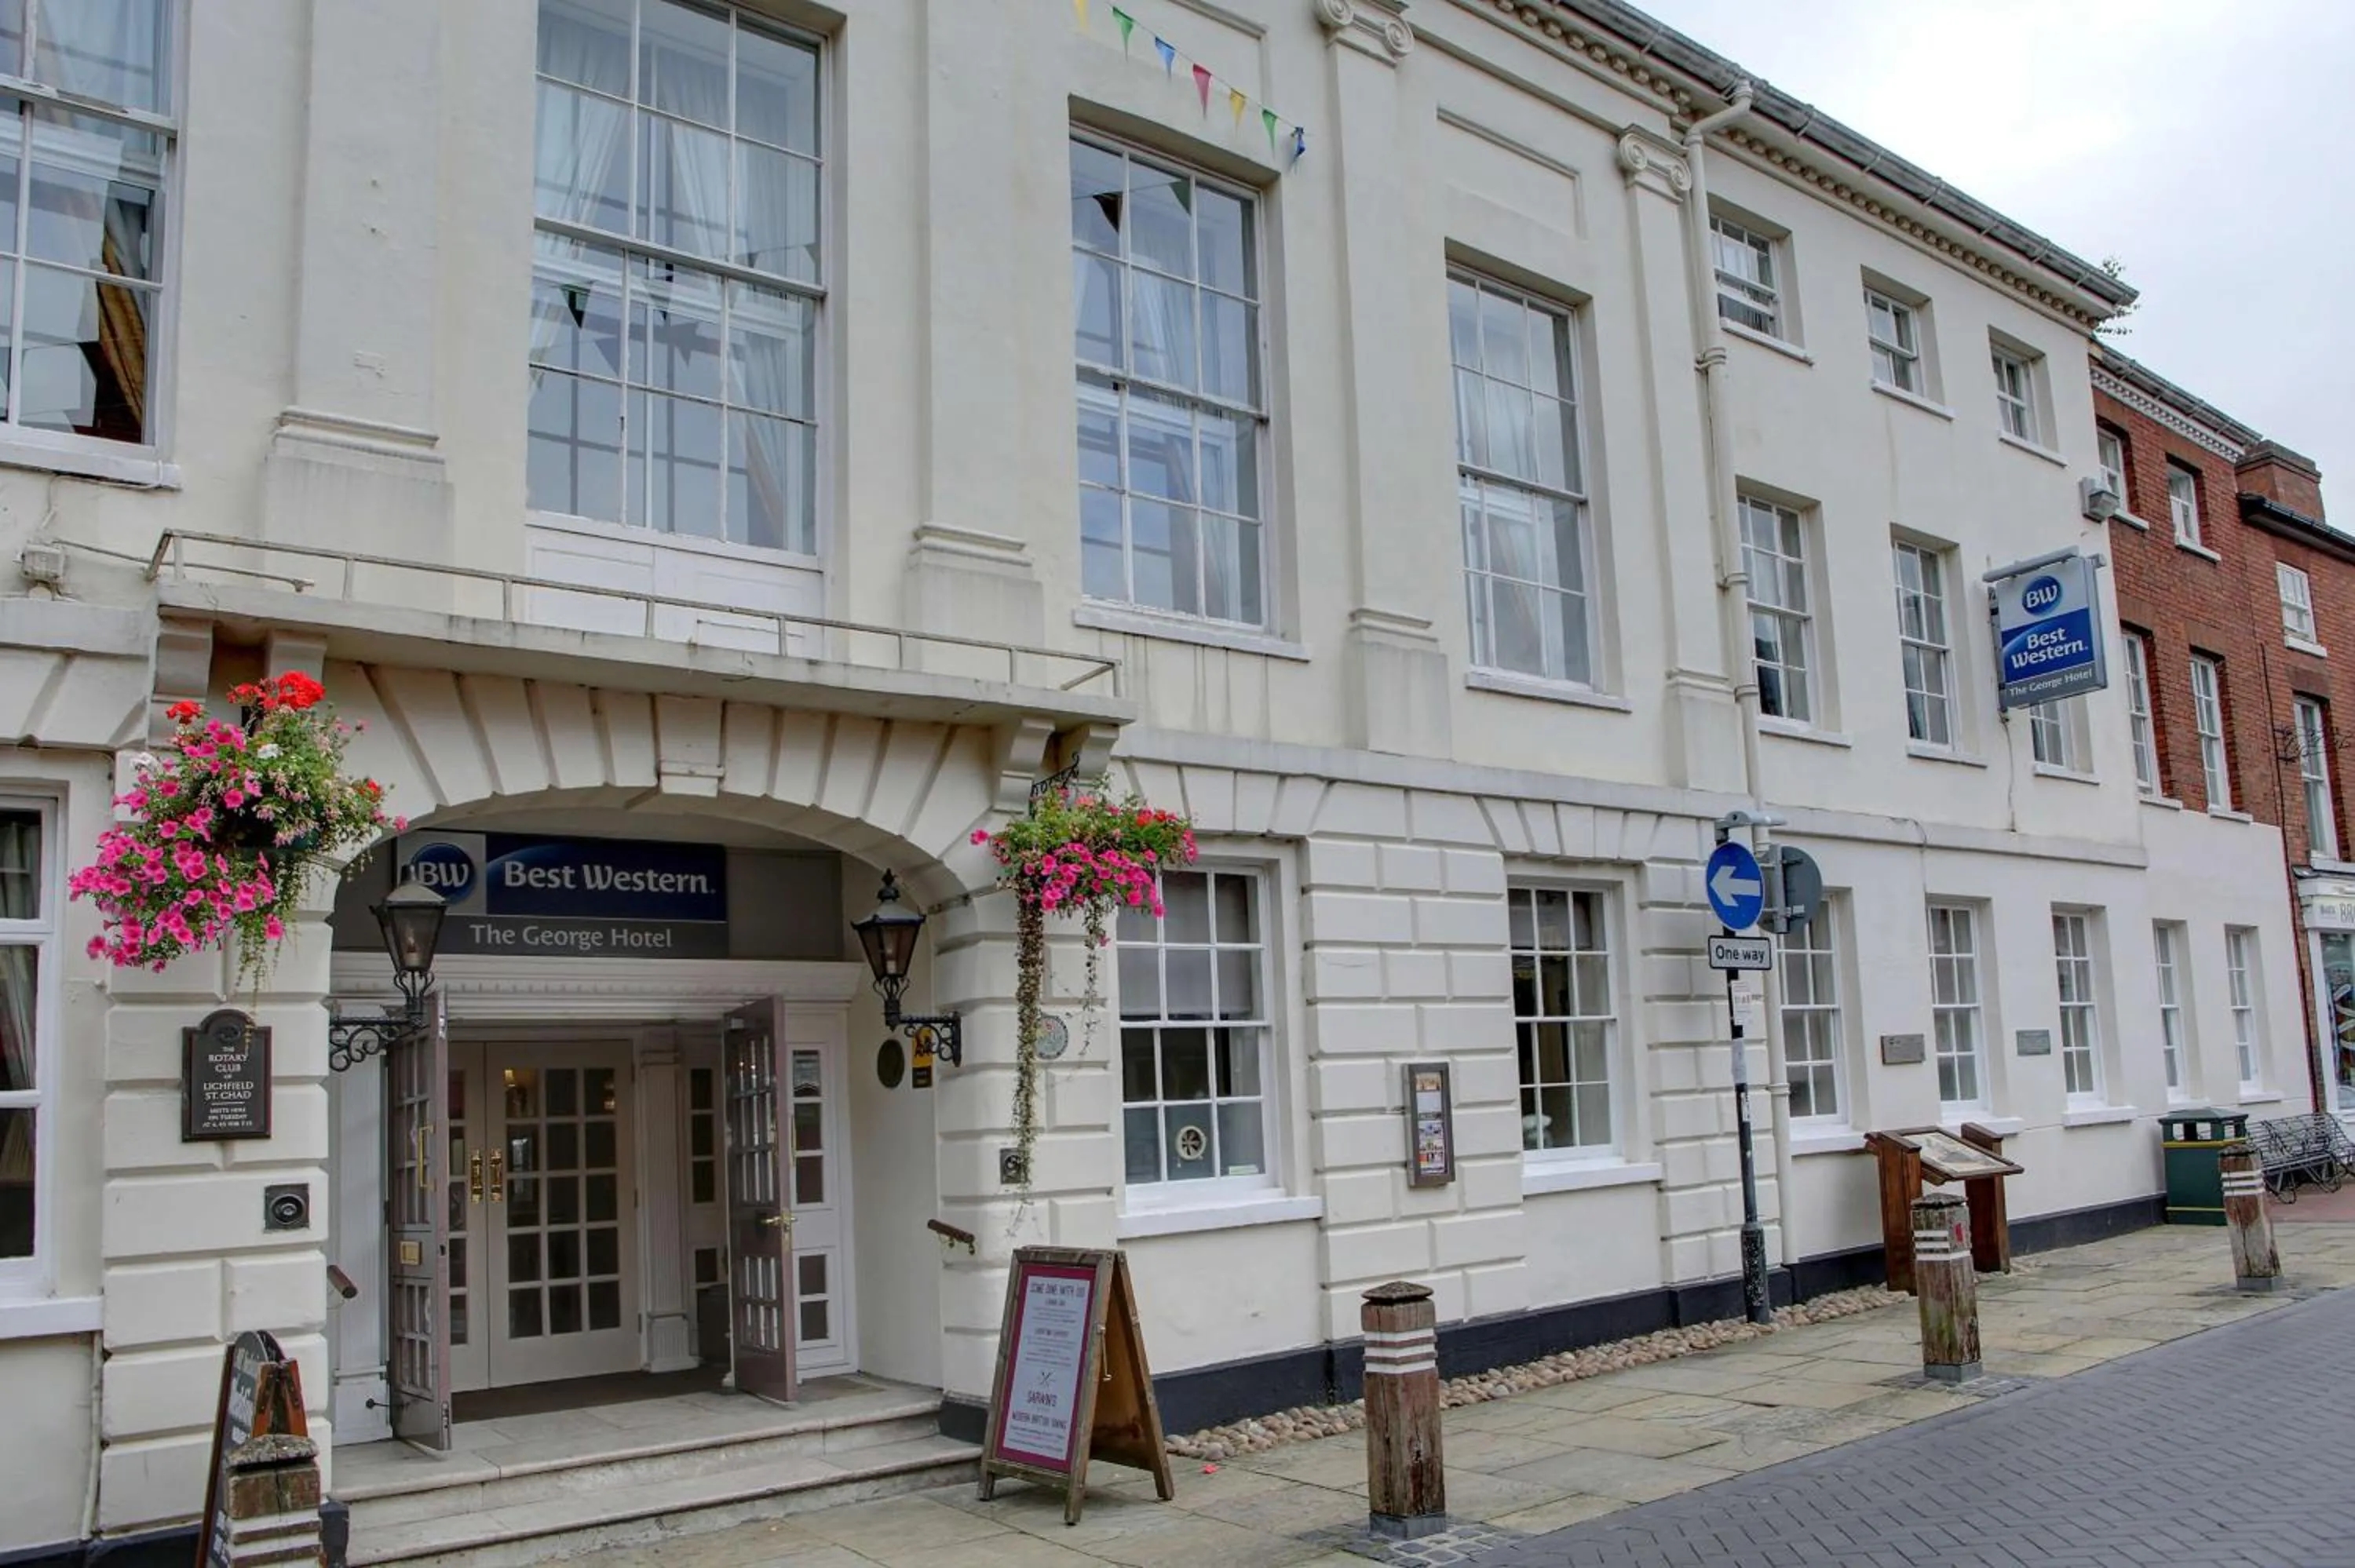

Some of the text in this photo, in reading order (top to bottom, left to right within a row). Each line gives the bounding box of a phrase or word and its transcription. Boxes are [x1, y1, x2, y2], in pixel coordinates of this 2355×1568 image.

[2026, 585, 2057, 608] BW
[2027, 627, 2066, 650] Best
[2011, 640, 2083, 669] Western
[2010, 668, 2093, 697] The George Hotel
[418, 861, 708, 894] BW Best Western
[469, 924, 672, 950] The George Hotel
[1715, 945, 1765, 964] One way
[208, 1054, 247, 1063] ROTARY
[215, 1063, 241, 1073] CLUB
[203, 1081, 254, 1090] LICHFIELD
[221, 1091, 252, 1099] CHAD
